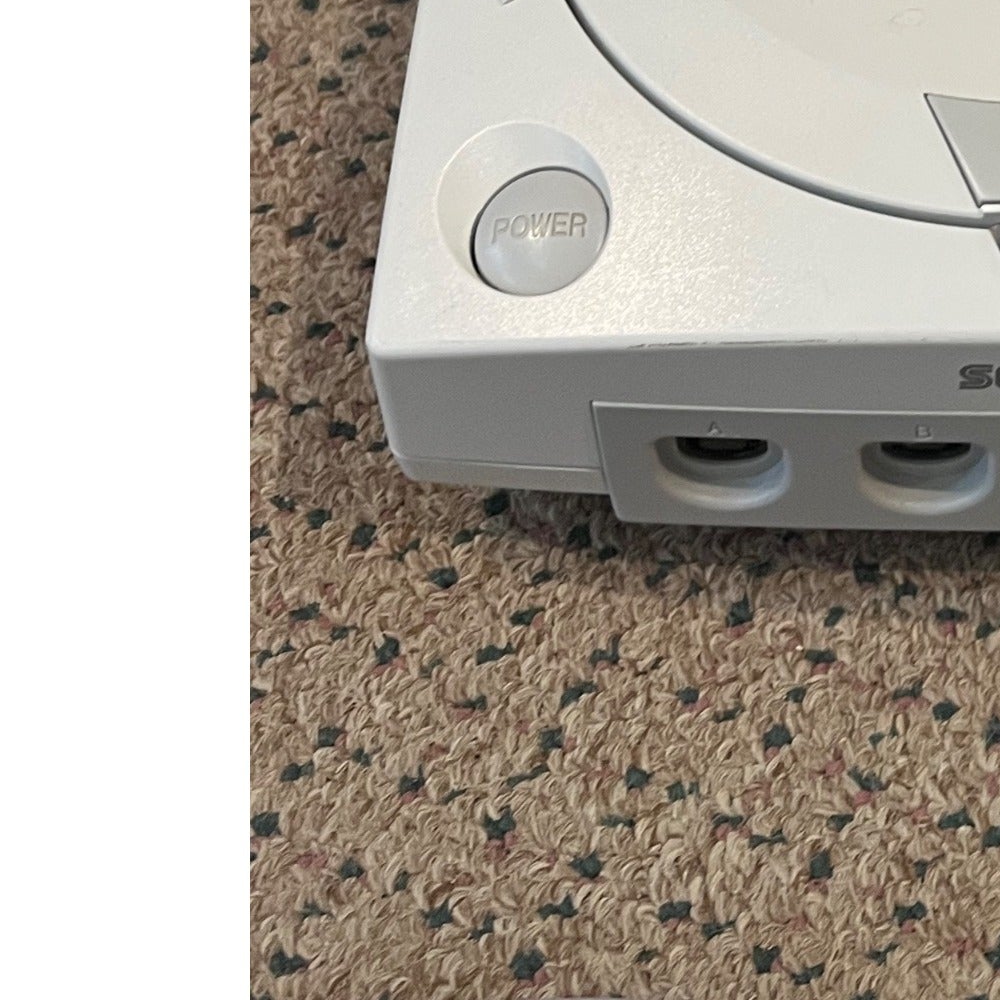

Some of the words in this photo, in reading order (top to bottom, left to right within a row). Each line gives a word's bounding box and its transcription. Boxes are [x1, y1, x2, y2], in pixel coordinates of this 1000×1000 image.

[491, 212, 588, 244] POWER
[706, 420, 722, 438] A
[914, 423, 932, 441] B
